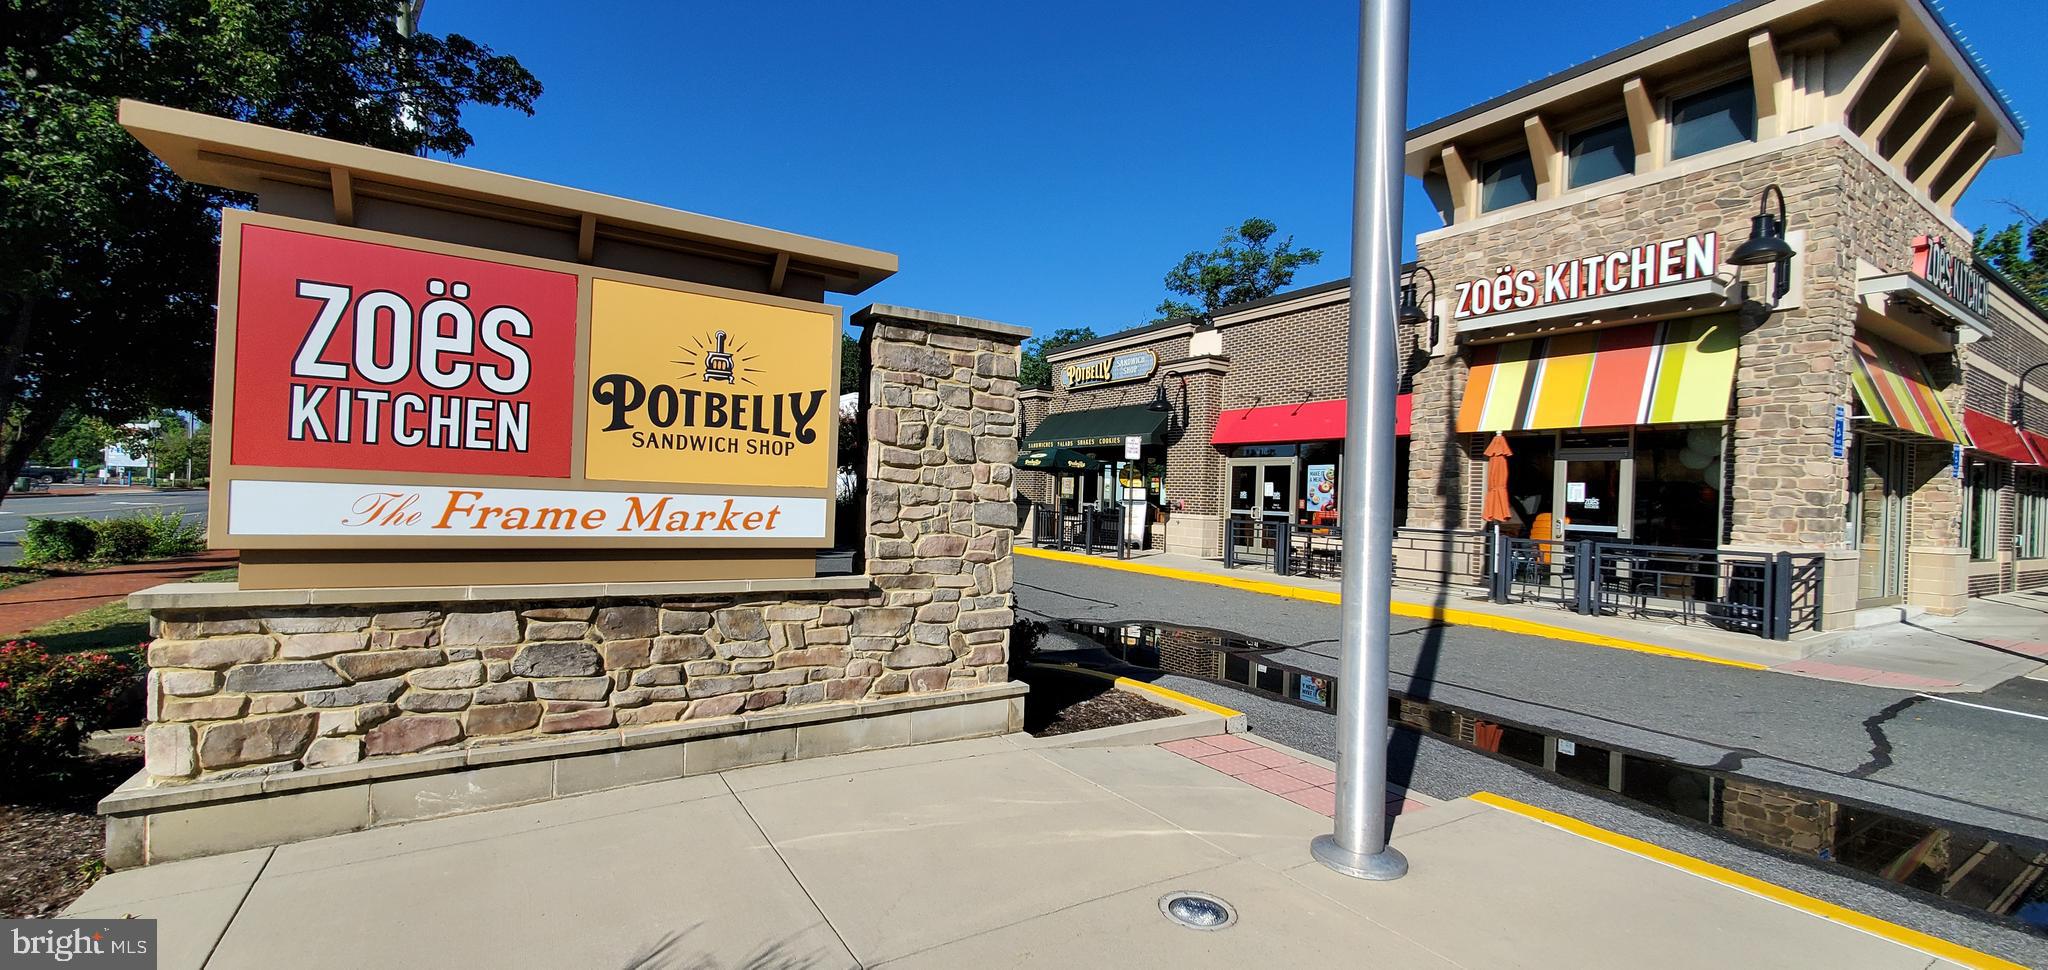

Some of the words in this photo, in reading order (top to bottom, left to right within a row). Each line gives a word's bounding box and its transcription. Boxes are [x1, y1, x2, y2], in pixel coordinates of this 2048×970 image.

[1543, 231, 1718, 303] KITCHEN
[1067, 357, 1115, 384] POTBELLY
[288, 384, 530, 453] KITCHEN
[592, 373, 828, 444] POTBELLY
[632, 431, 739, 453] SANDWICH
[746, 438, 796, 457] SHOP
[341, 492, 423, 527] The
[431, 490, 607, 532] Frame
[617, 496, 782, 533] Market
